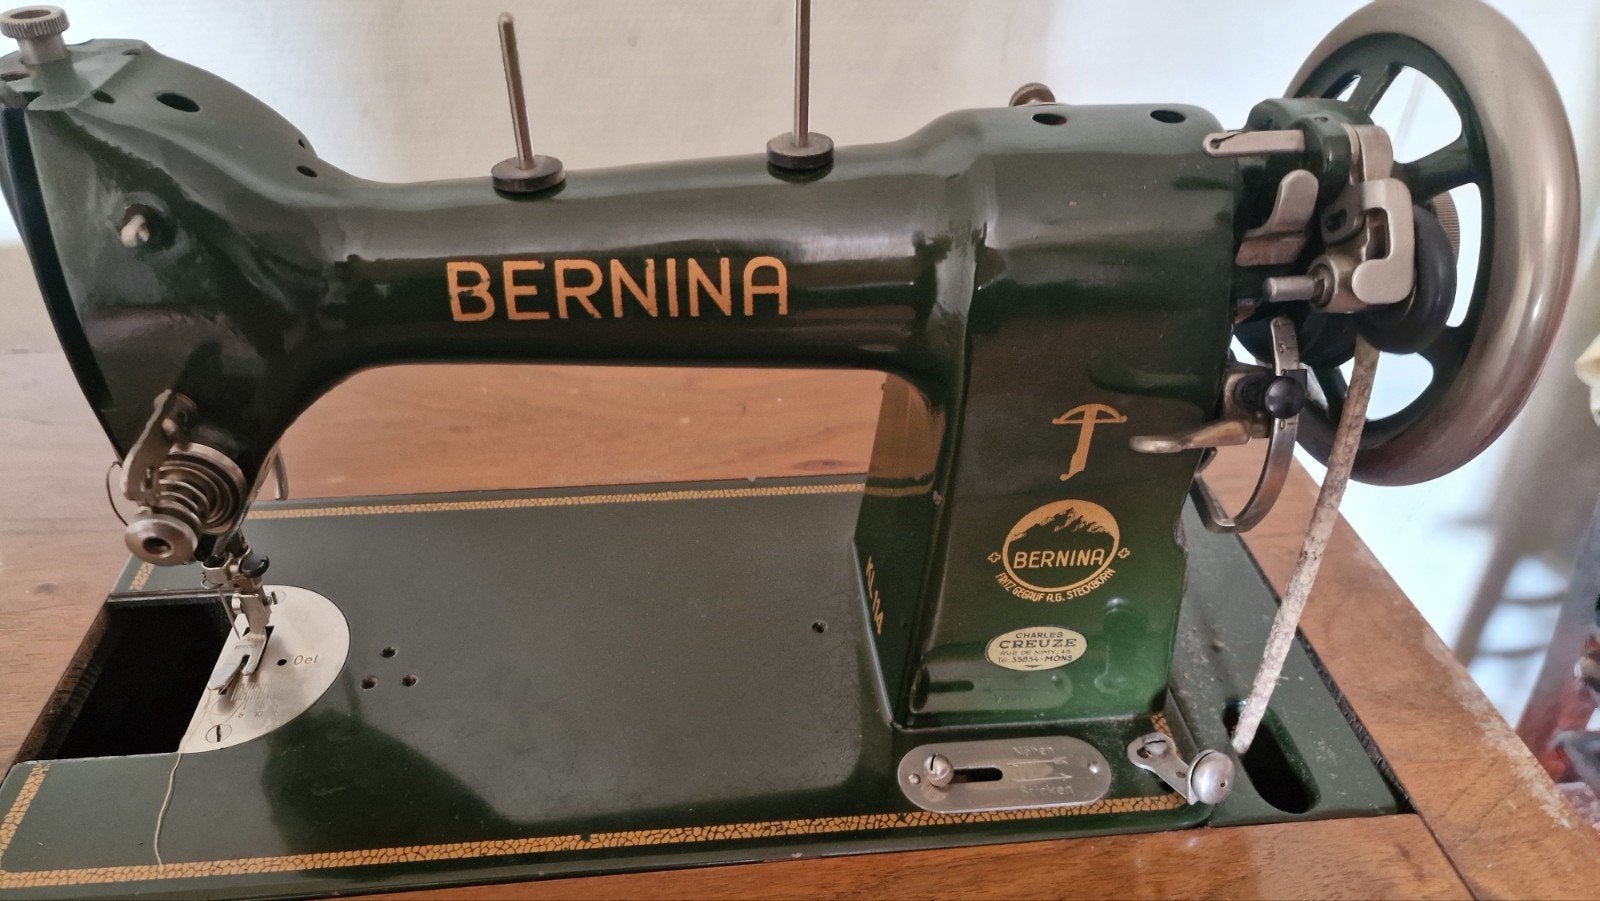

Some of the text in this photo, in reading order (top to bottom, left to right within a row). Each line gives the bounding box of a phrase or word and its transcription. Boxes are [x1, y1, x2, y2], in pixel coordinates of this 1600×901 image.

[446, 256, 788, 322] BERNINA
[1013, 548, 1106, 569] BERNINA
[995, 571, 1013, 591] FRITZ
[1012, 586, 1046, 602] GEGAUF
[1066, 568, 1116, 600] STECKBORN
[1015, 631, 1064, 639] CHARLES
[999, 638, 1077, 649] CREUZE
[293, 654, 318, 665] Oel
